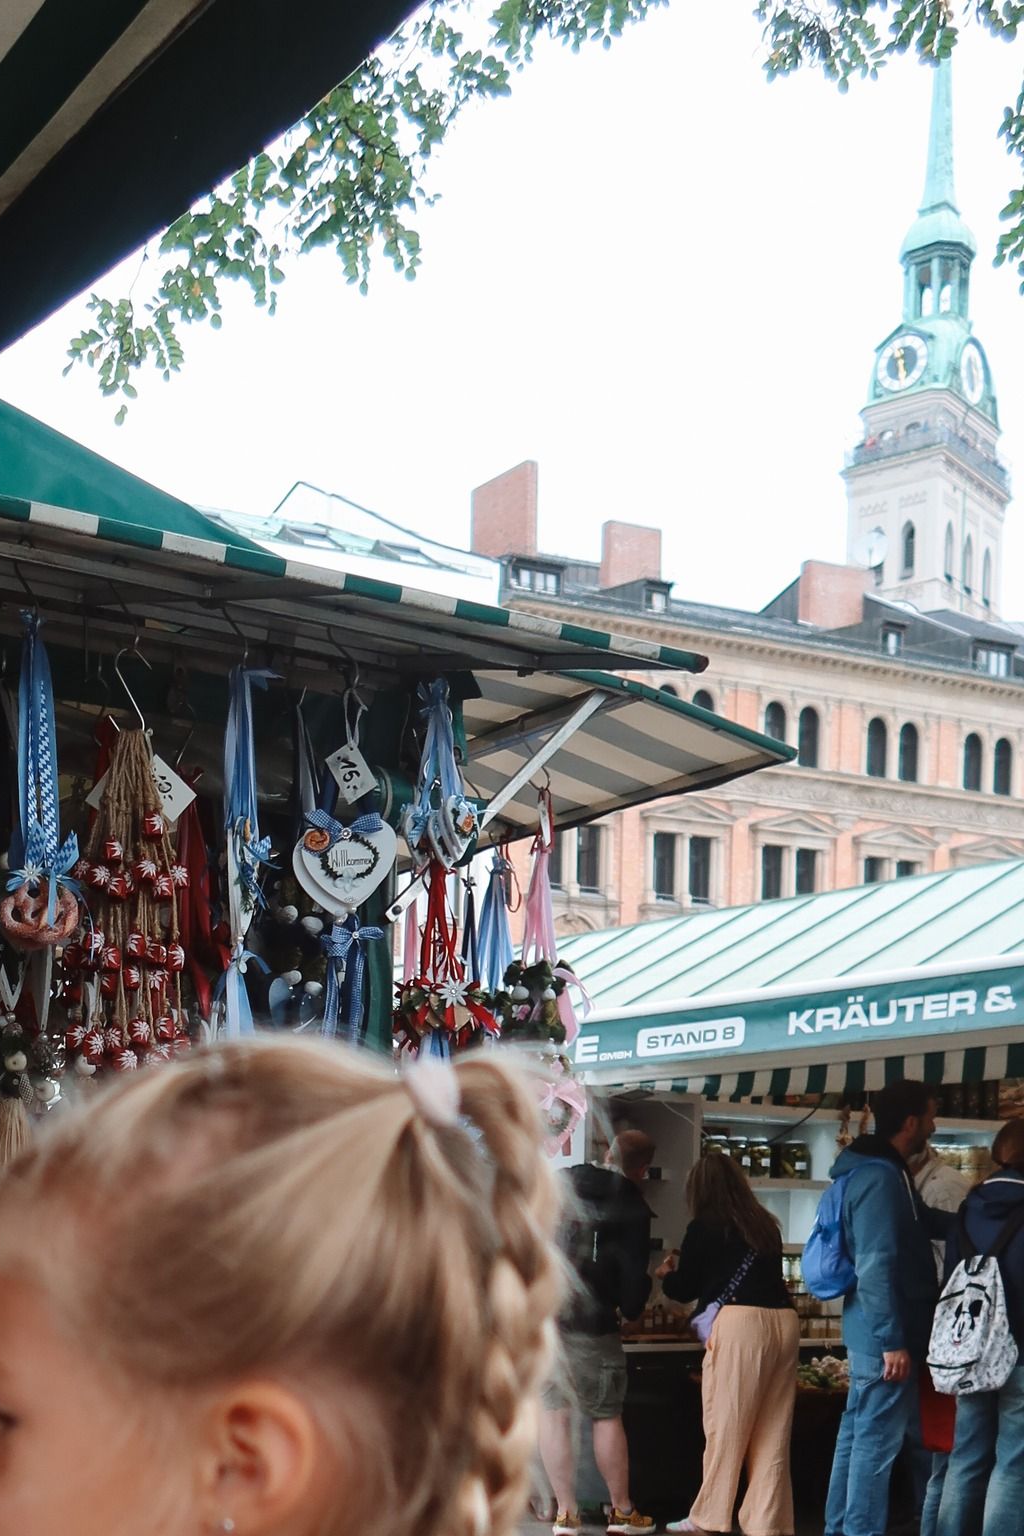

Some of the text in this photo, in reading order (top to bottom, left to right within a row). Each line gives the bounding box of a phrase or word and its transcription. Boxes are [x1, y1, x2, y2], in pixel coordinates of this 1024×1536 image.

[787, 985, 1017, 1036] KRÄUTER &
[646, 1026, 736, 1049] STAND 8
